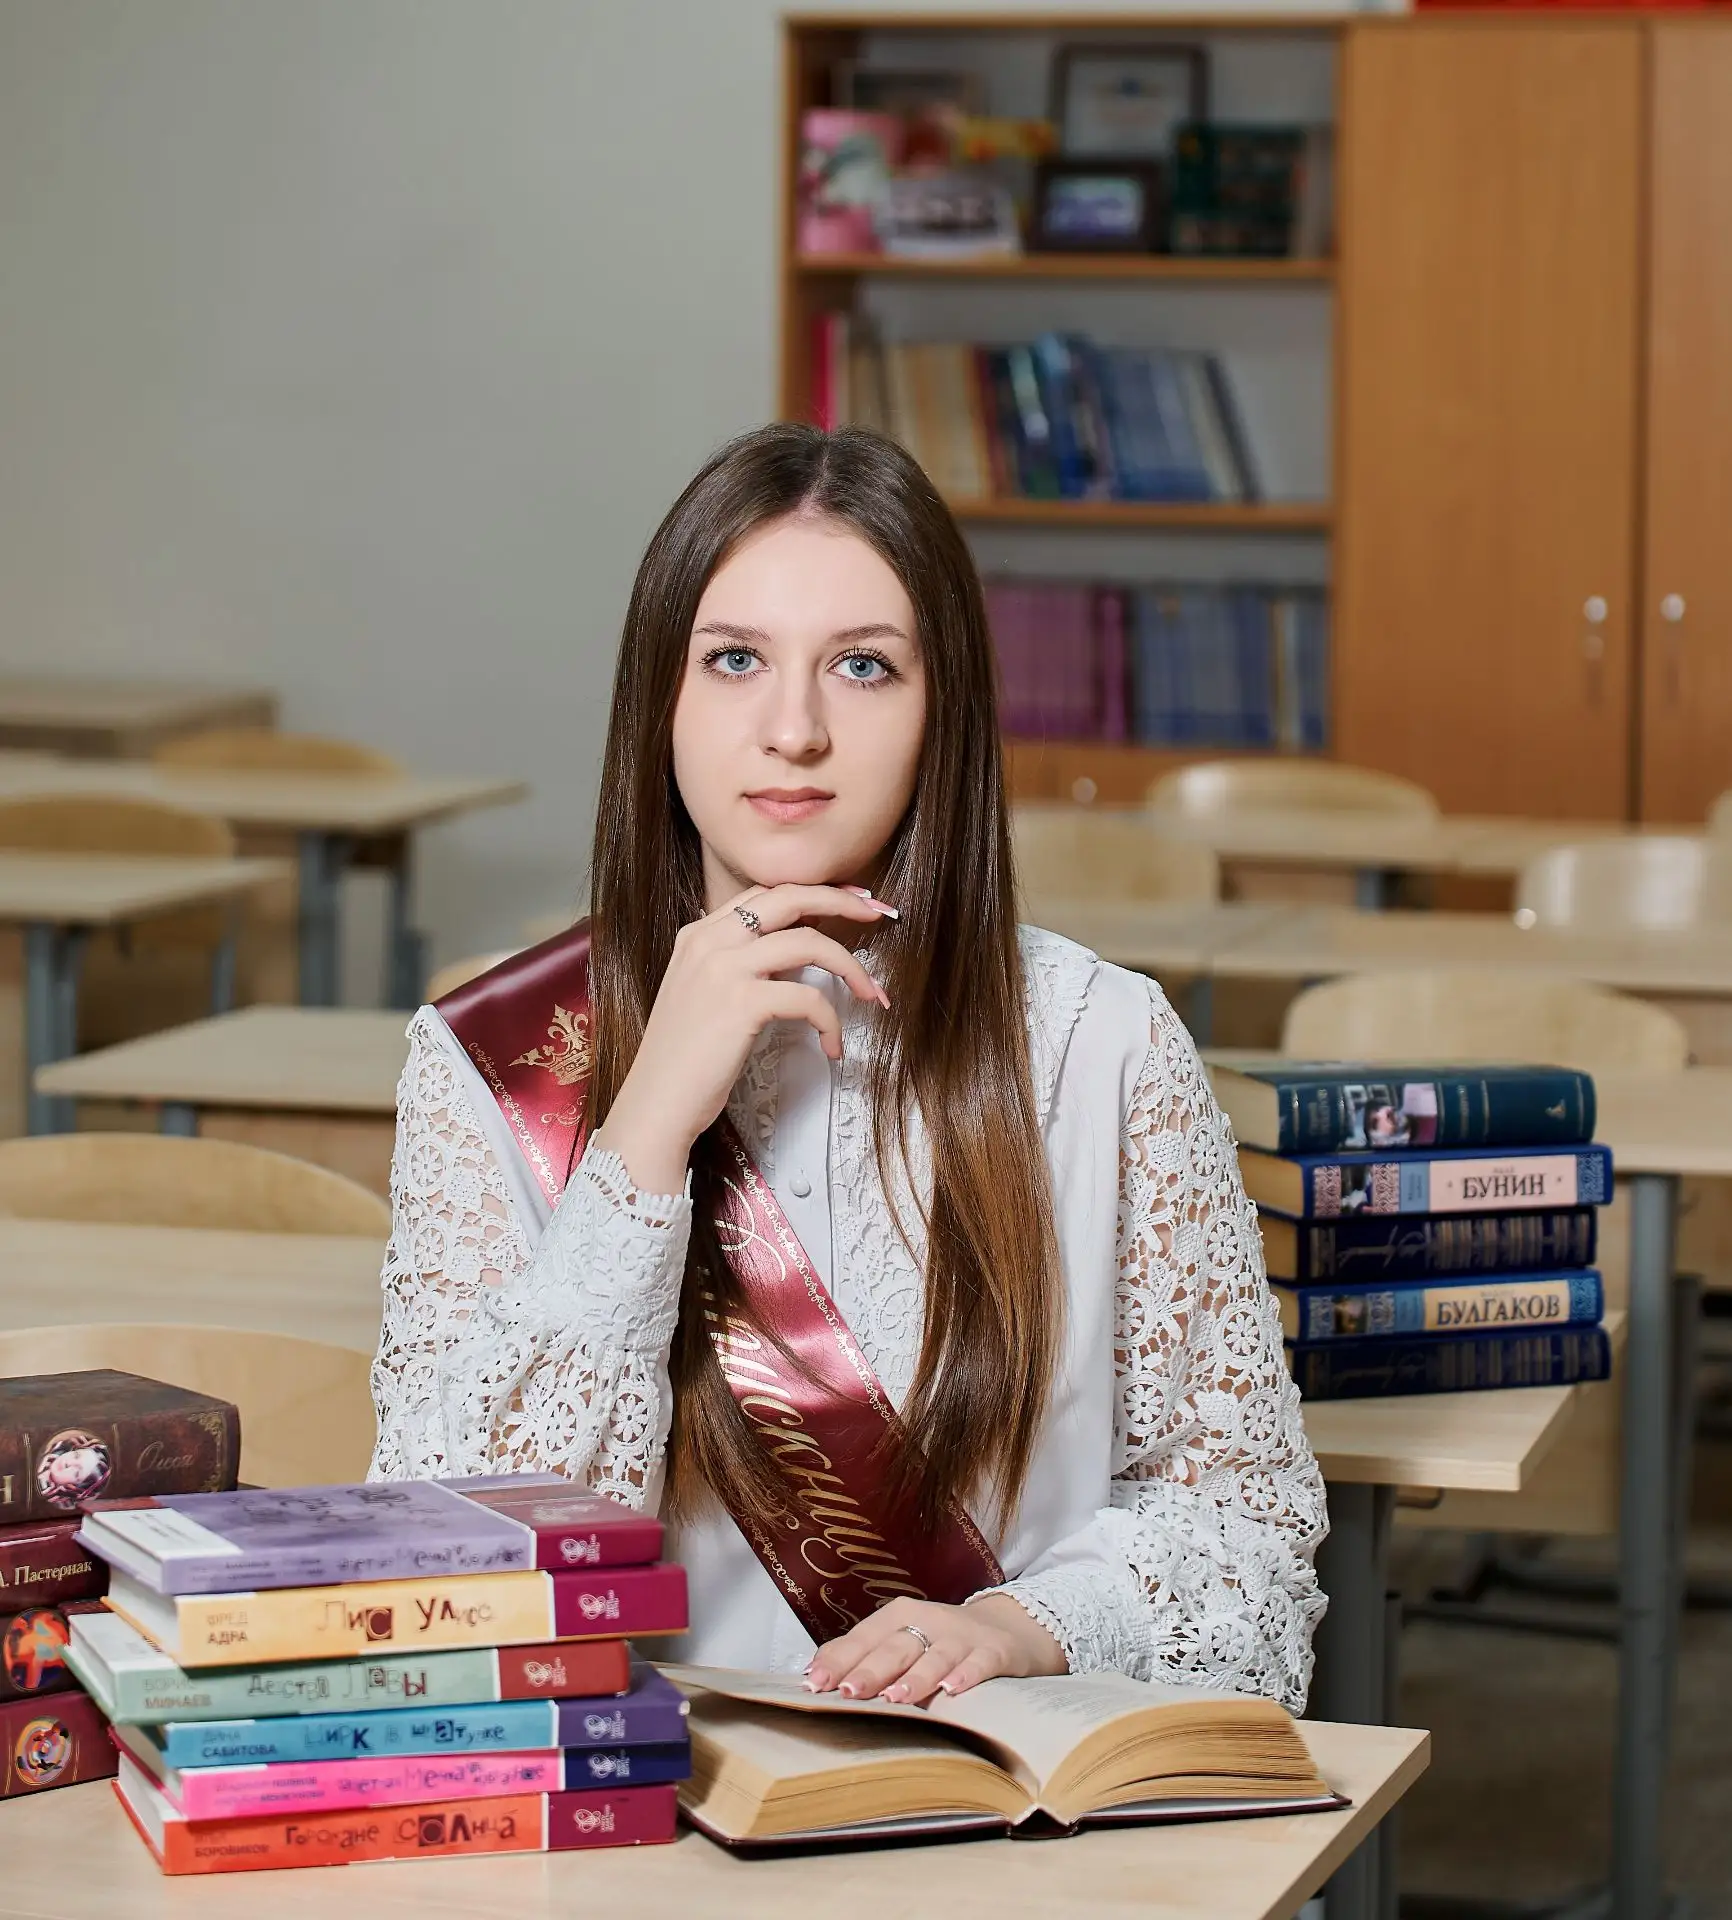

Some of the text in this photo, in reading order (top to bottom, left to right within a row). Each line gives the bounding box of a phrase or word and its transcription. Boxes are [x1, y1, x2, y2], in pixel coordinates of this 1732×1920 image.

[1462, 1173, 1546, 1199] БУНИН
[1437, 1295, 1560, 1326] БУЛГАКОВ
[14, 1561, 92, 1586] Пастернак
[207, 1630, 248, 1646] АДРА
